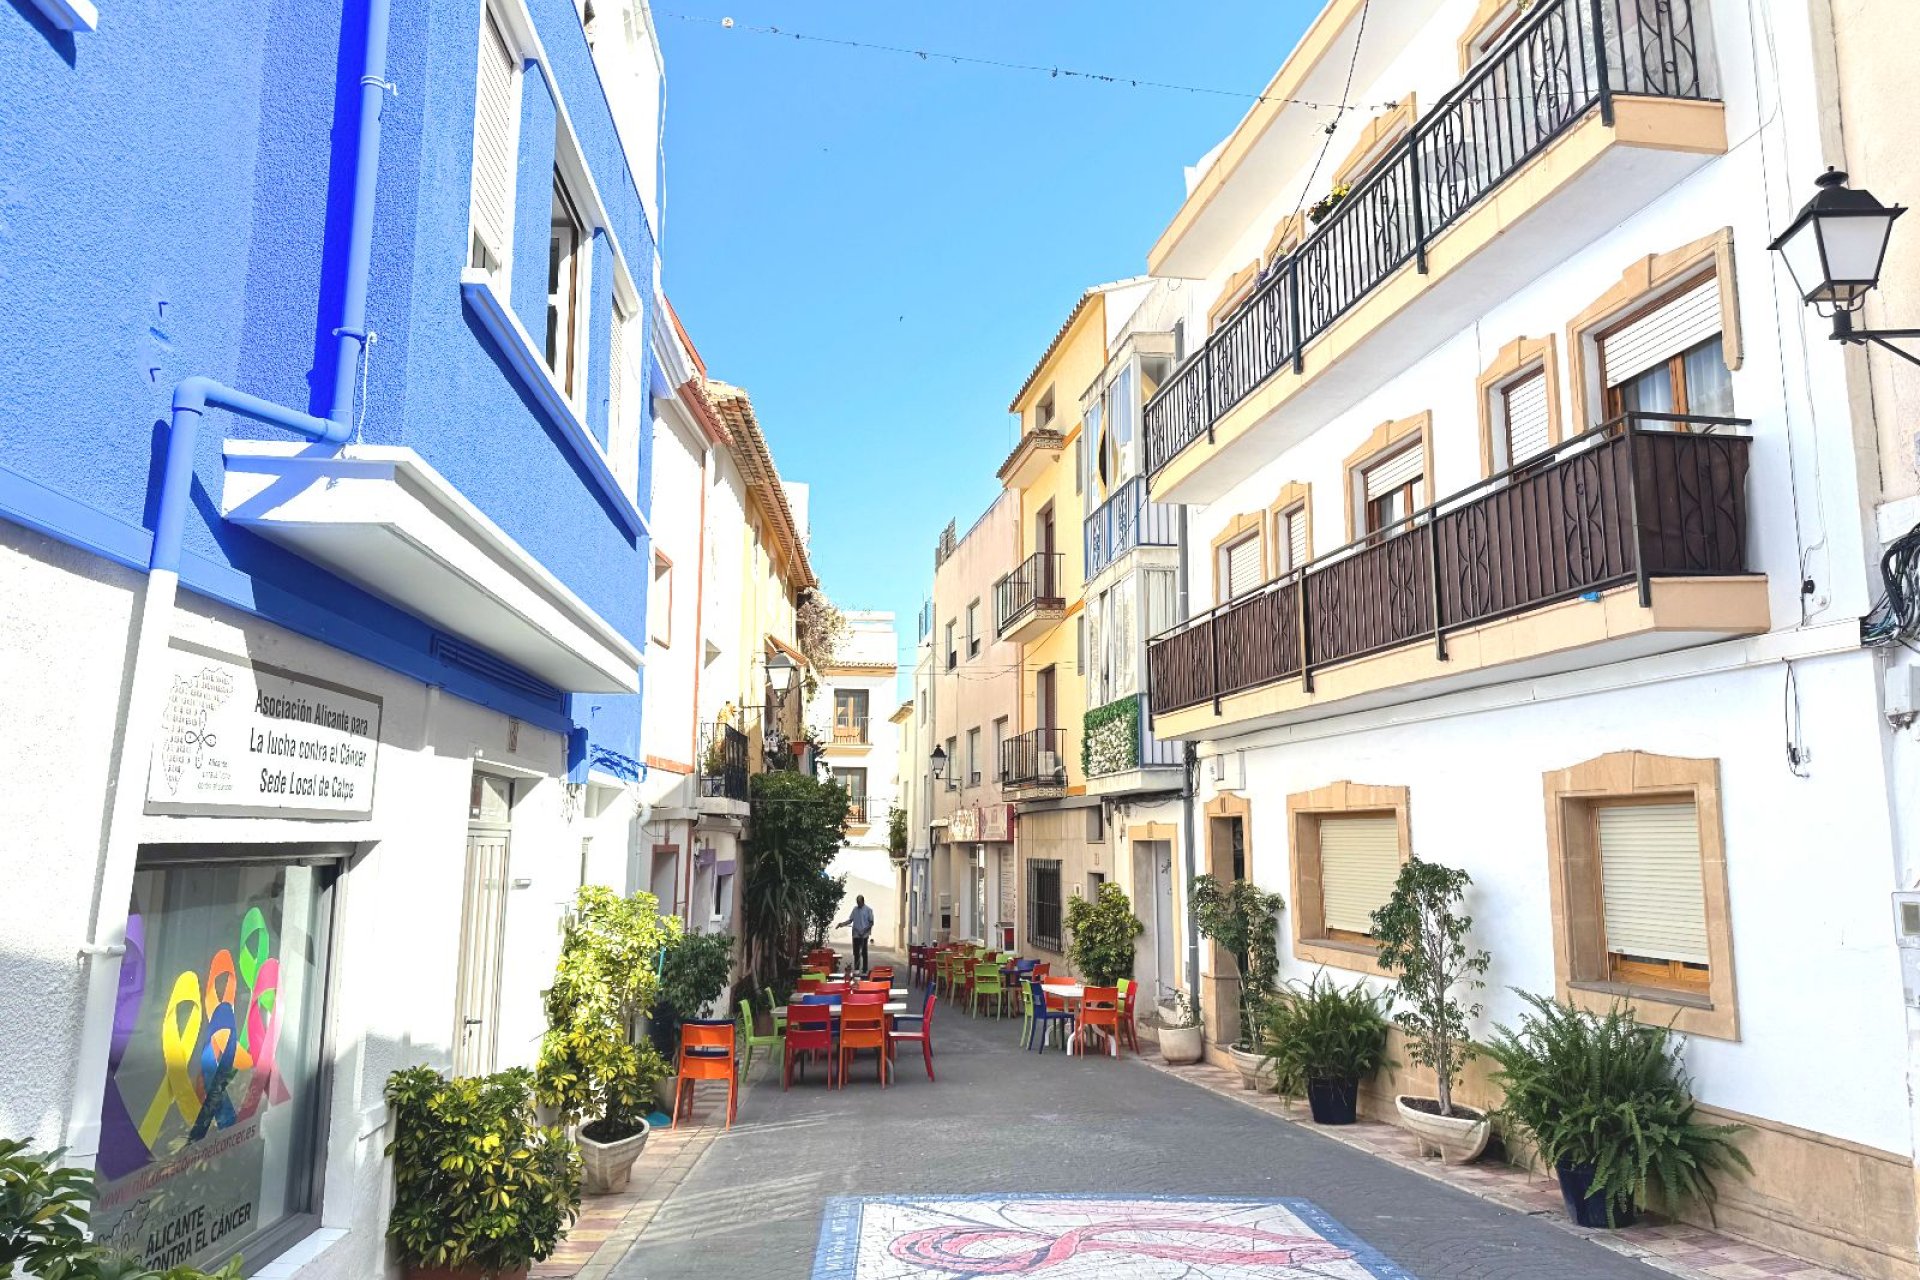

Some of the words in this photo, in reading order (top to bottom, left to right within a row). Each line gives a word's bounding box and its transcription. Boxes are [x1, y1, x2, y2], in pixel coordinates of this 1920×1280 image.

[254, 689, 312, 723] Asociación
[314, 703, 349, 732] Alicante
[350, 716, 368, 737] para
[249, 727, 264, 753] La
[267, 730, 296, 757] lucha
[299, 739, 328, 762] contra
[329, 743, 338, 763] el
[340, 743, 367, 768] Cáncer
[260, 767, 287, 794] Sede
[289, 771, 317, 796] Local
[318, 775, 330, 797] de
[331, 776, 355, 802] Calpe
[145, 1204, 206, 1259] ALICANTE
[195, 1228, 208, 1253] EL
[210, 1202, 252, 1243] CÁNCER
